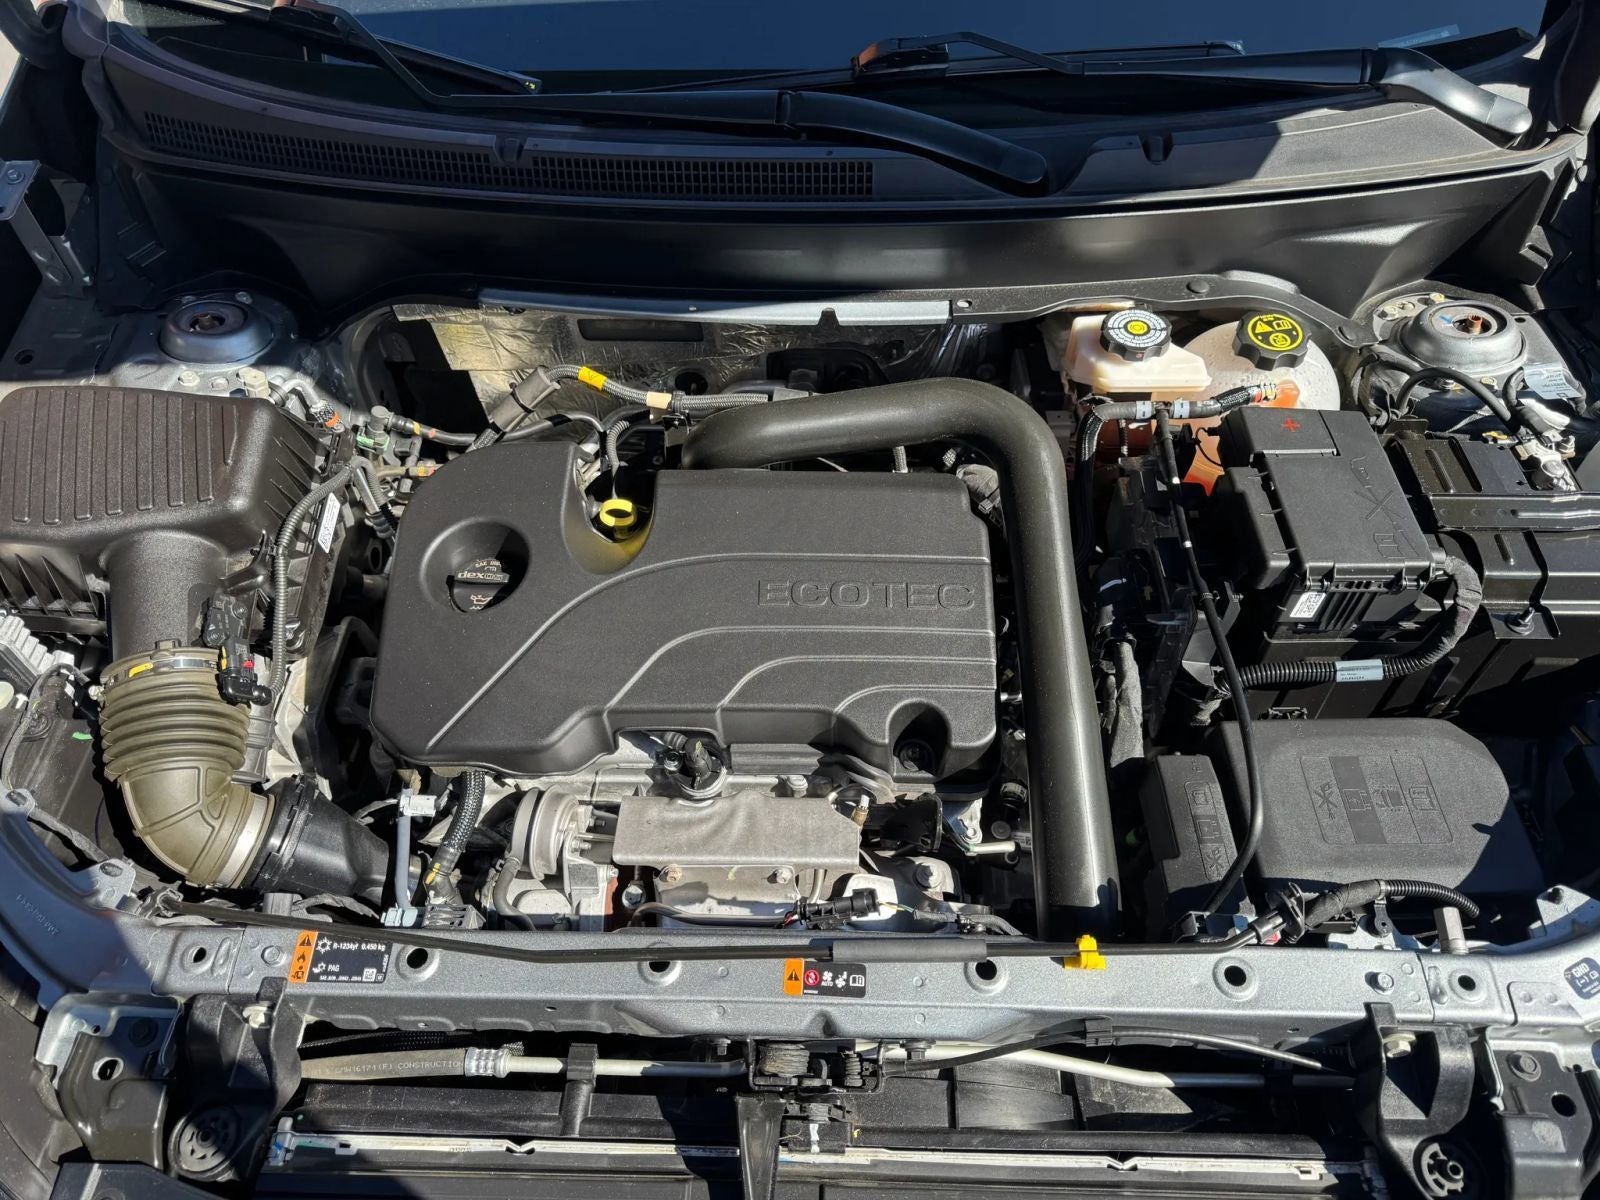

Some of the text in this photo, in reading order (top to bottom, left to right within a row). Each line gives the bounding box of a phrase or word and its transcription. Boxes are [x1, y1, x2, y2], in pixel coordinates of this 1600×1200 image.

[757, 579, 976, 610] ECOTEC
[332, 942, 386, 952] R-1234yf 0.450 kg
[327, 964, 340, 972] PAG
[1571, 962, 1590, 978] GND
[397, 1060, 464, 1071] CONSTRUCTION
